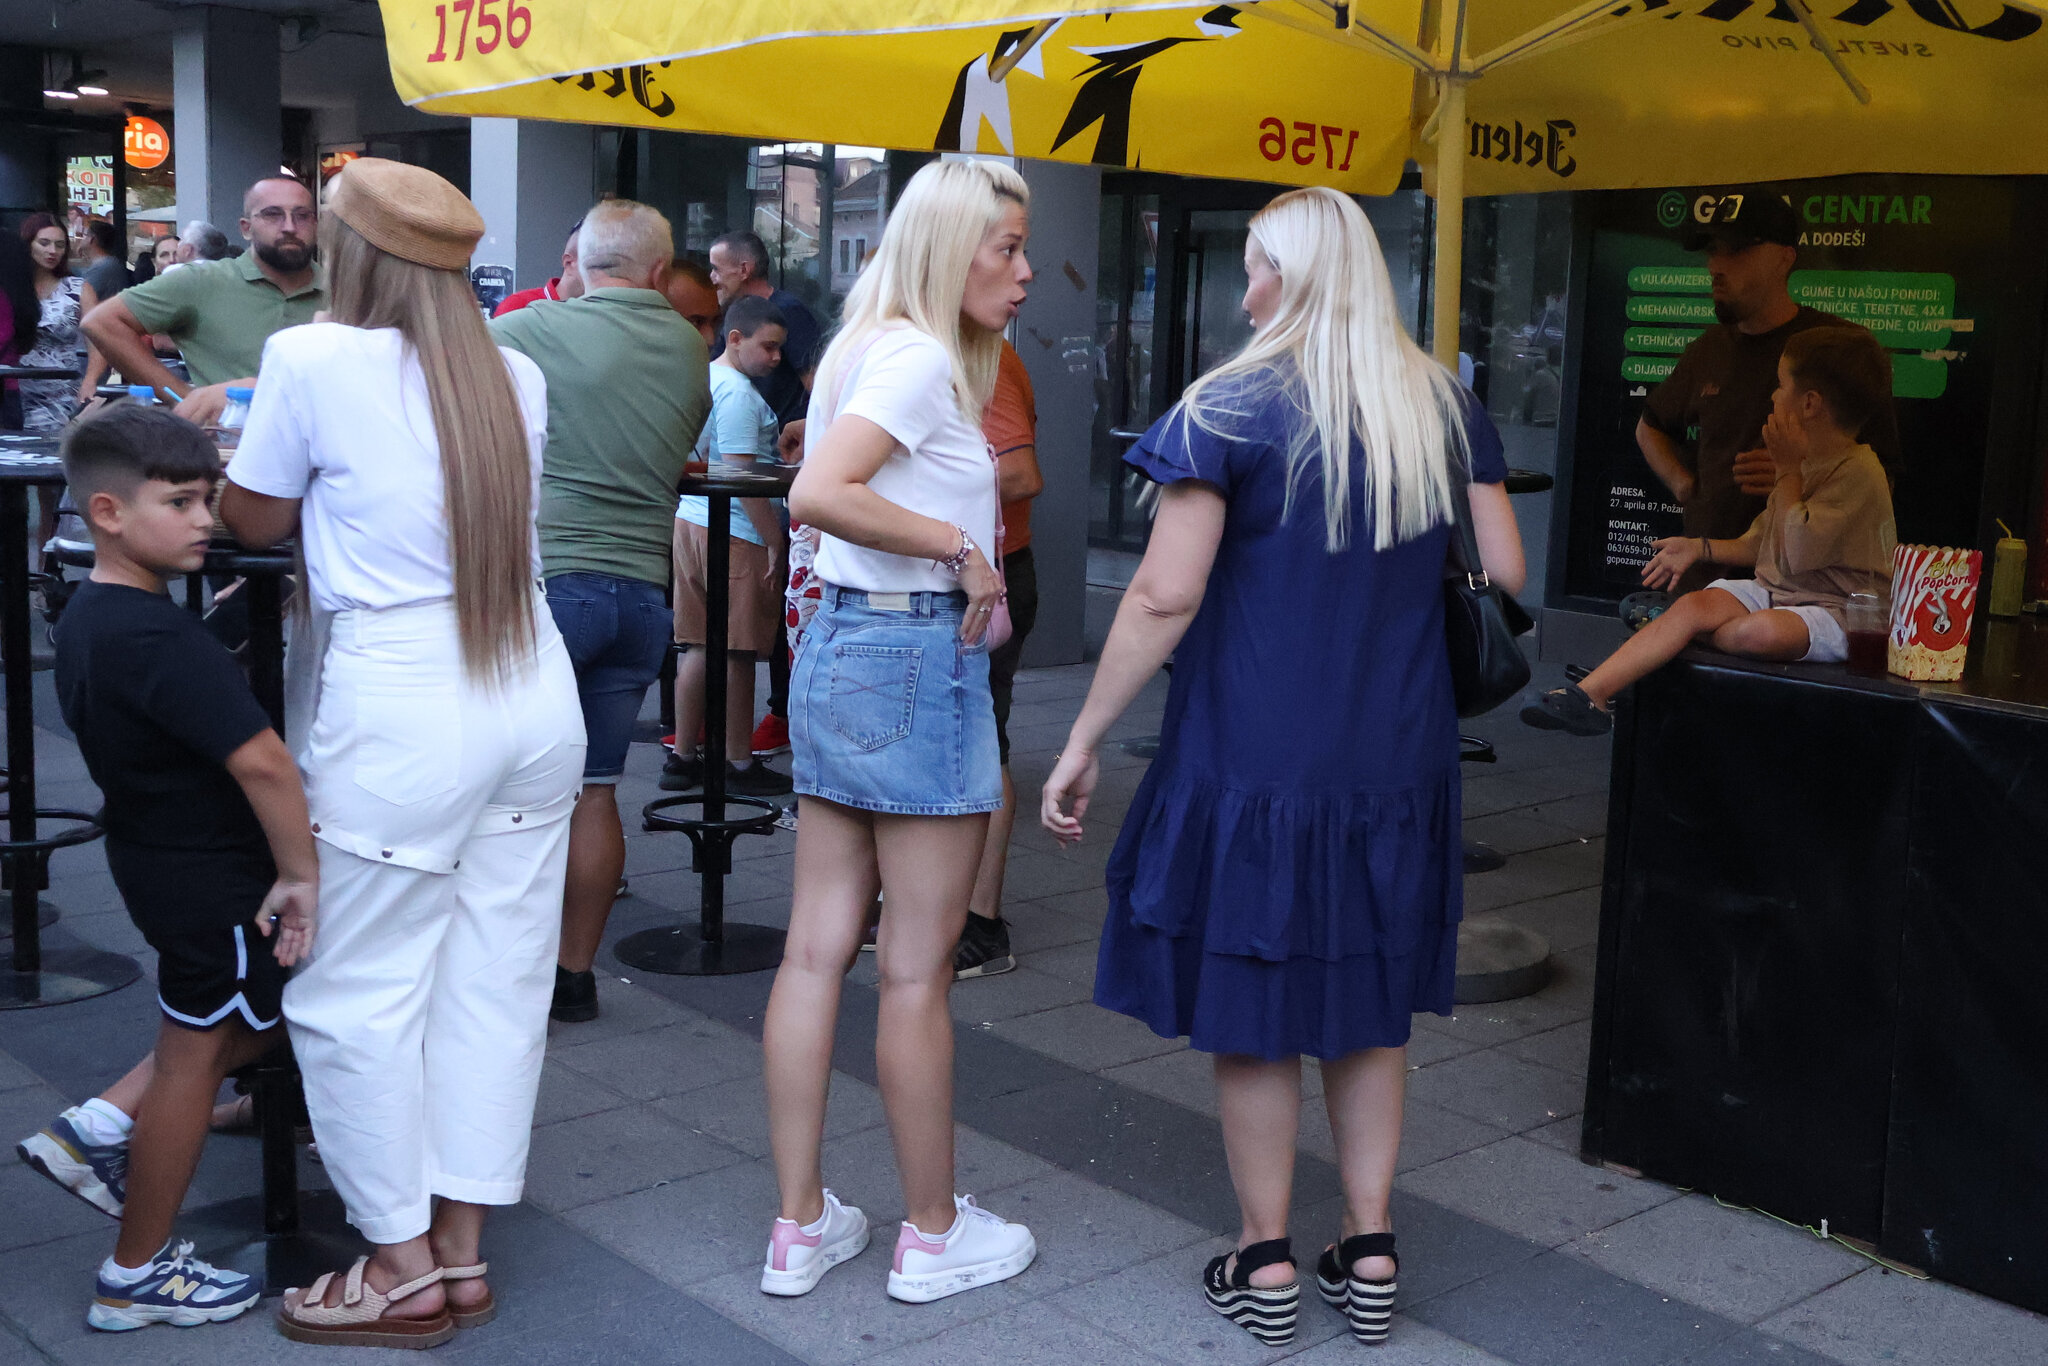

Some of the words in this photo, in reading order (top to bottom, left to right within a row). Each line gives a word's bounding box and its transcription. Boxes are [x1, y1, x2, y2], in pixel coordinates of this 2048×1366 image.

[427, 0, 531, 62] 1756
[124, 123, 163, 150] ria
[1803, 195, 1933, 224] CENTAR
[1813, 228, 1866, 247] DOĐEŠ!
[1640, 274, 1713, 286] VULKANIZERS
[1802, 287, 1837, 298] GUME
[1838, 287, 1846, 298] U
[1850, 285, 1888, 300] NAŠOJ
[1891, 289, 1940, 300] PONUDI:
[1863, 303, 1919, 317] TERETNE,
[1923, 305, 1945, 316] 4X4
[1637, 333, 1685, 347] TEHNIČKI
[1611, 486, 1646, 498] ADRESA:
[1610, 498, 1622, 508] 27.
[1624, 501, 1645, 511] aprila
[1647, 502, 1659, 513] 87,
[1609, 520, 1650, 532] KONTAKT:
[1607, 543, 1657, 556] 063/659-012
[1930, 558, 1968, 578] BIG
[1921, 573, 1971, 592] PopCorn
